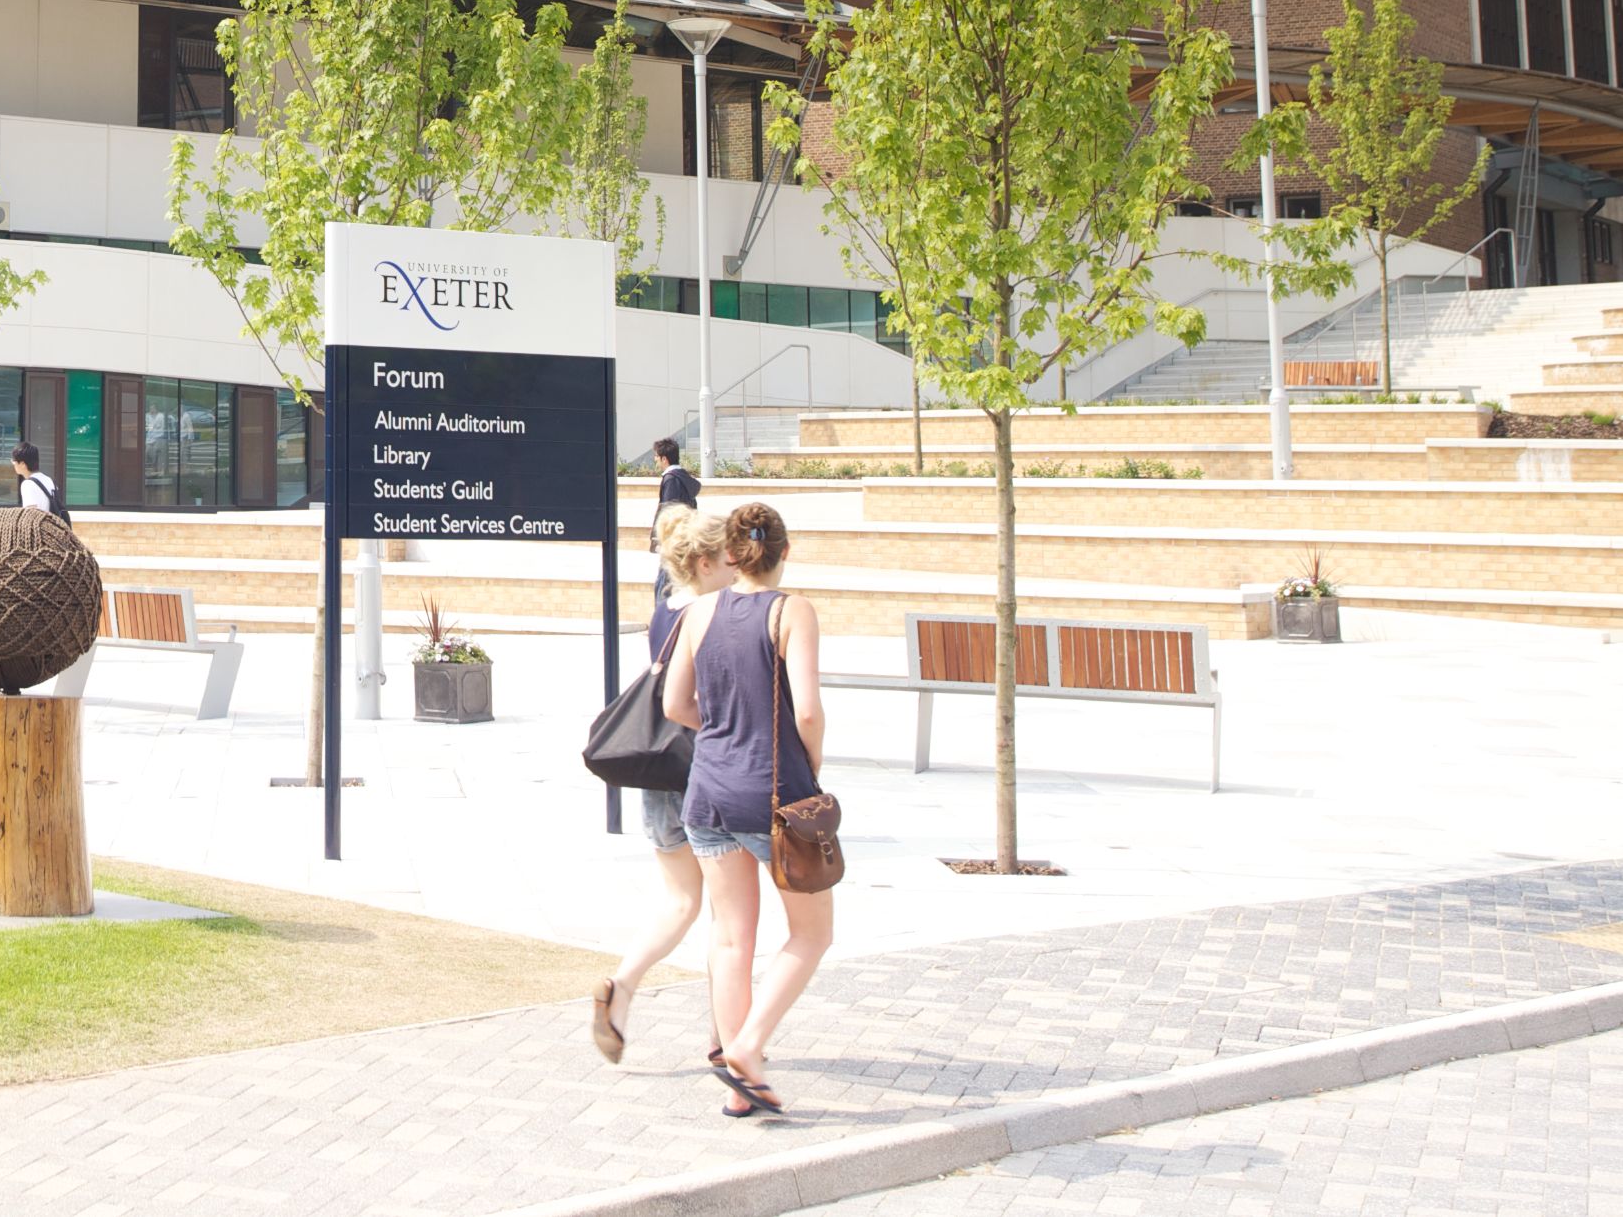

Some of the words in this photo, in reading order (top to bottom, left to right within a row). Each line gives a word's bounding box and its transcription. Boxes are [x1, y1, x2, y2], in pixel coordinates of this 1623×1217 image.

[407, 262, 487, 276] UNIVERSITY
[493, 267, 509, 277] OF
[374, 261, 514, 331] EXETER
[373, 362, 444, 389] Forum
[374, 410, 432, 431] Alumni
[436, 412, 525, 434] Auditorium
[373, 444, 431, 470] Library
[374, 478, 447, 500] Students'
[451, 480, 494, 500] Guild
[373, 512, 437, 533] Student
[440, 514, 505, 534] Services
[509, 515, 565, 535] Centre
